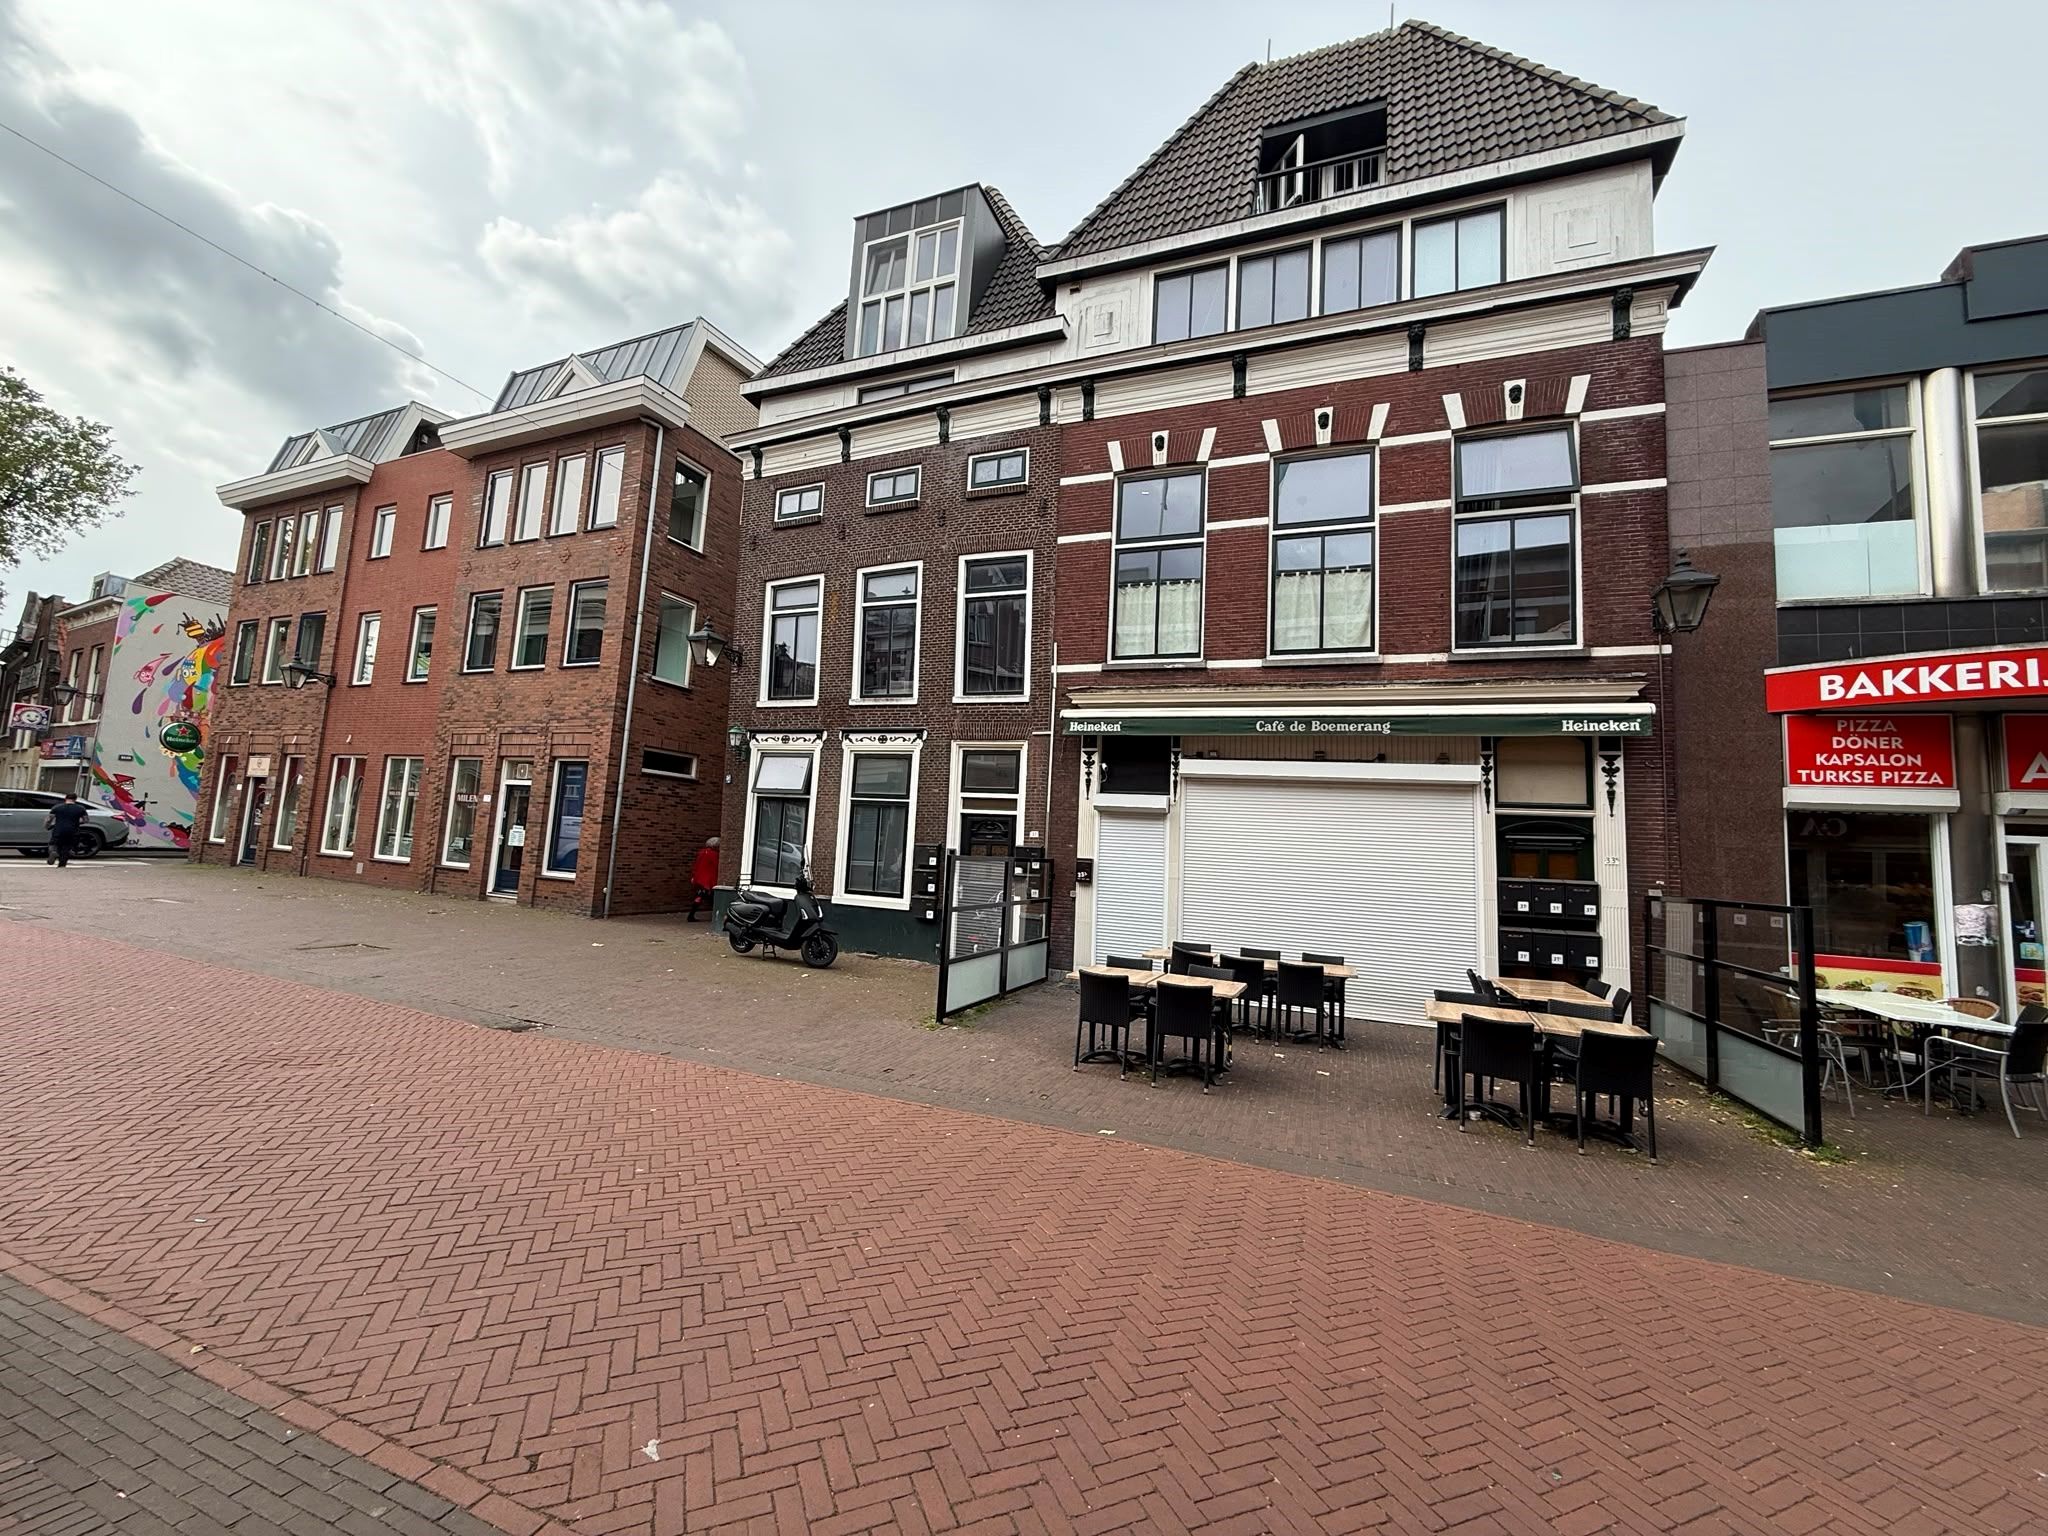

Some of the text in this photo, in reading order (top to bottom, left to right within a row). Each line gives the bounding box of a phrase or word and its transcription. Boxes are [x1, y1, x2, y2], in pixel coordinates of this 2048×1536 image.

[1818, 657, 2048, 702] BAKKERI
[1069, 721, 1122, 732] Heineken
[1255, 720, 1391, 735] Café de Boemerang
[1561, 719, 1641, 732] Heineken
[1836, 719, 1898, 733] PIZZA
[1831, 733, 1904, 750] DÖNER
[1815, 753, 1922, 768] KAPSALON
[1797, 769, 1944, 785] TURKSE PIZZA
